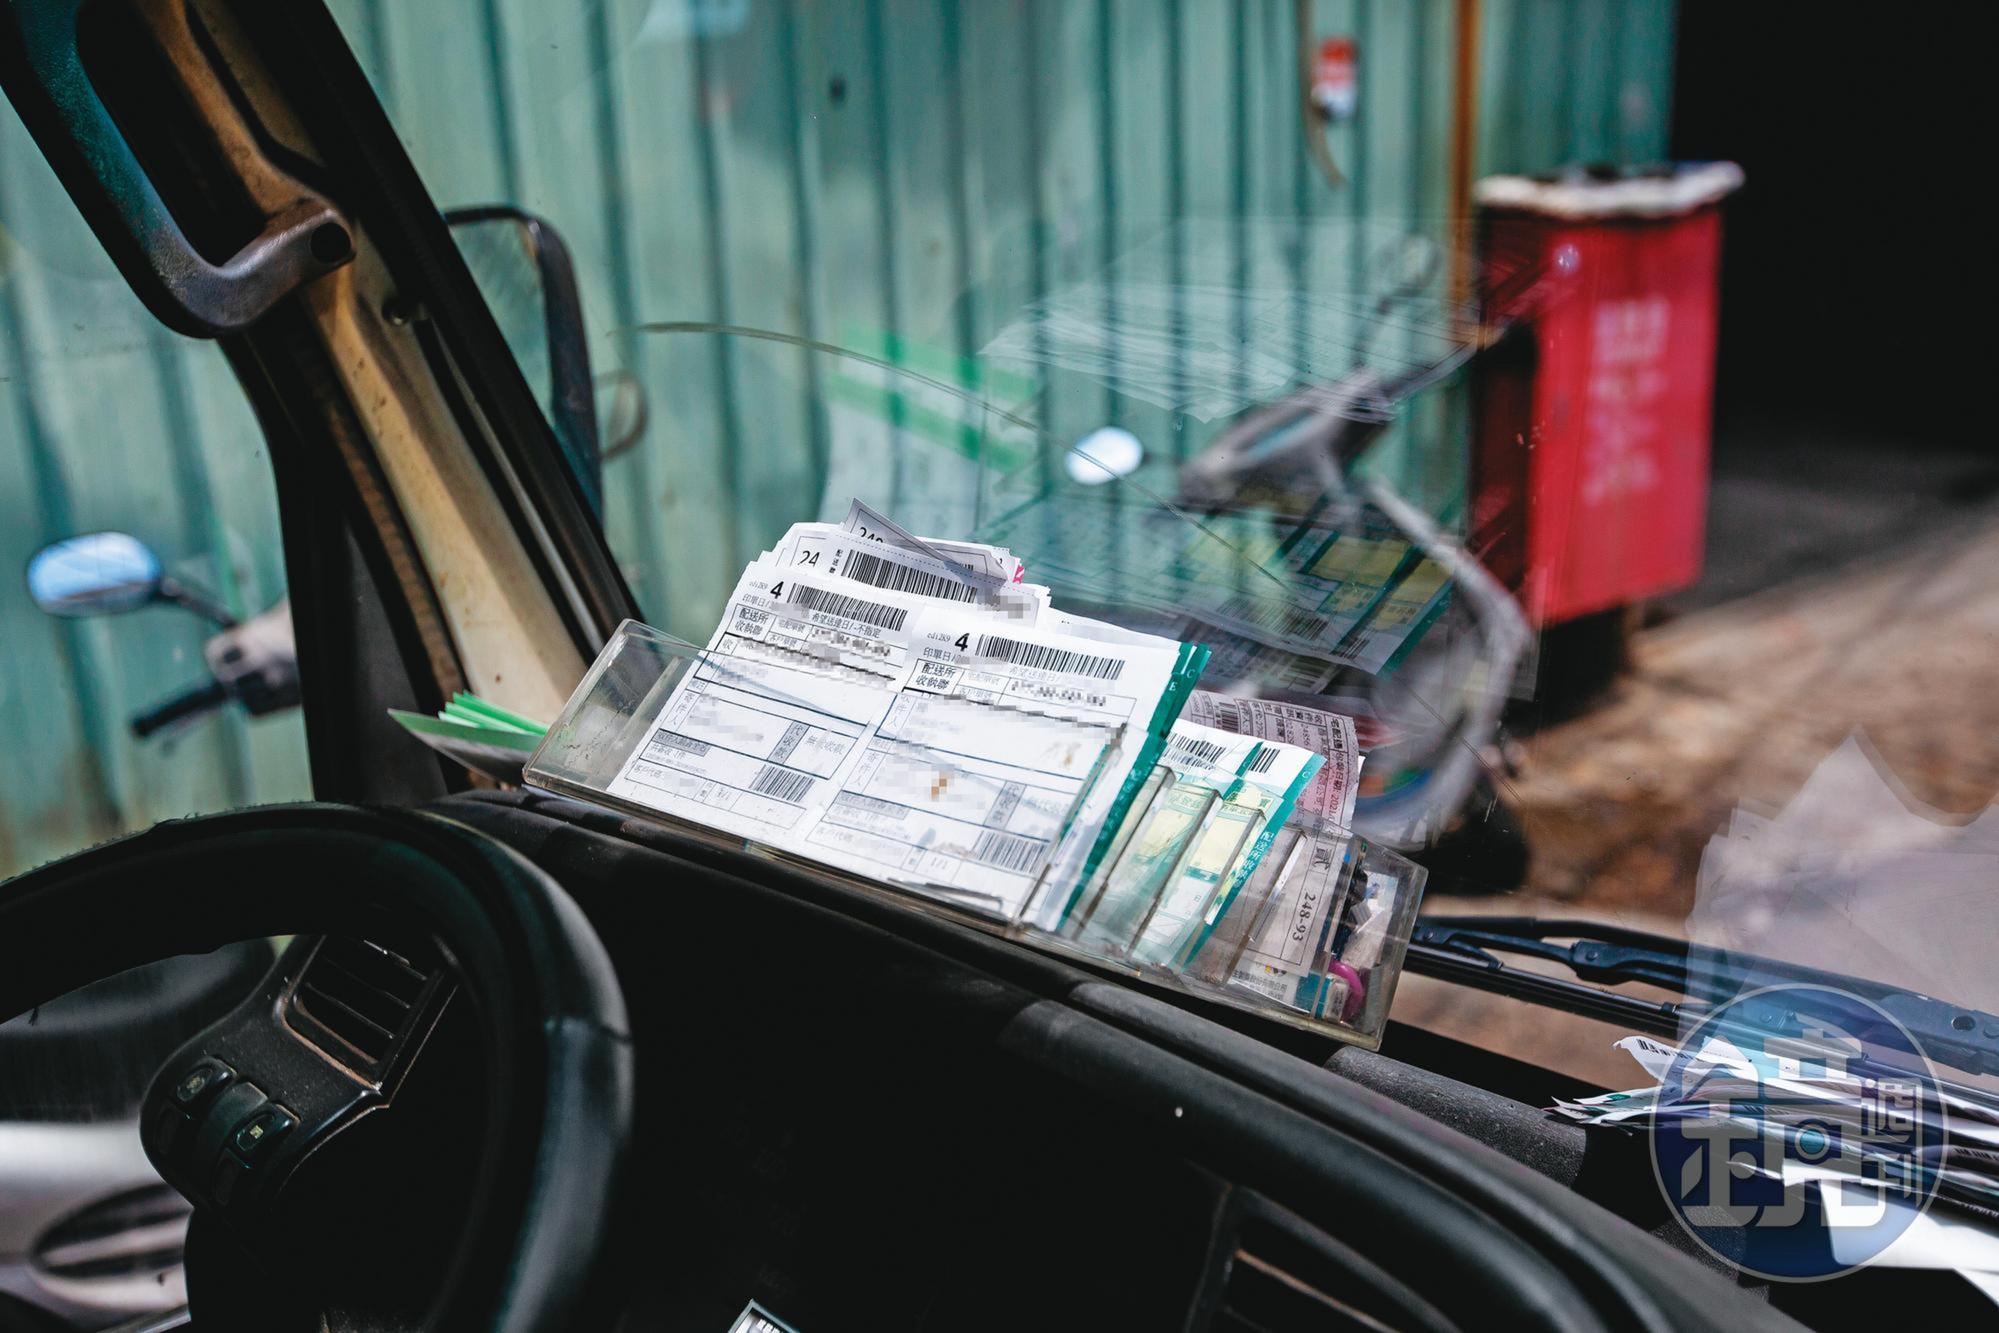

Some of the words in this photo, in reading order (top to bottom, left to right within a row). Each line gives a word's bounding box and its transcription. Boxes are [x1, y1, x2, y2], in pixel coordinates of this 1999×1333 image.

[769, 580, 785, 600] 4
[738, 607, 770, 625] 配送所
[734, 620, 764, 637] 收執聯
[954, 632, 970, 652] 4
[921, 662, 957, 679] 配送所
[915, 674, 950, 690] 收執聯
[1168, 681, 1178, 692] E
[1330, 717, 1343, 750] 宅配通
[1293, 890, 1315, 942] 248-93
